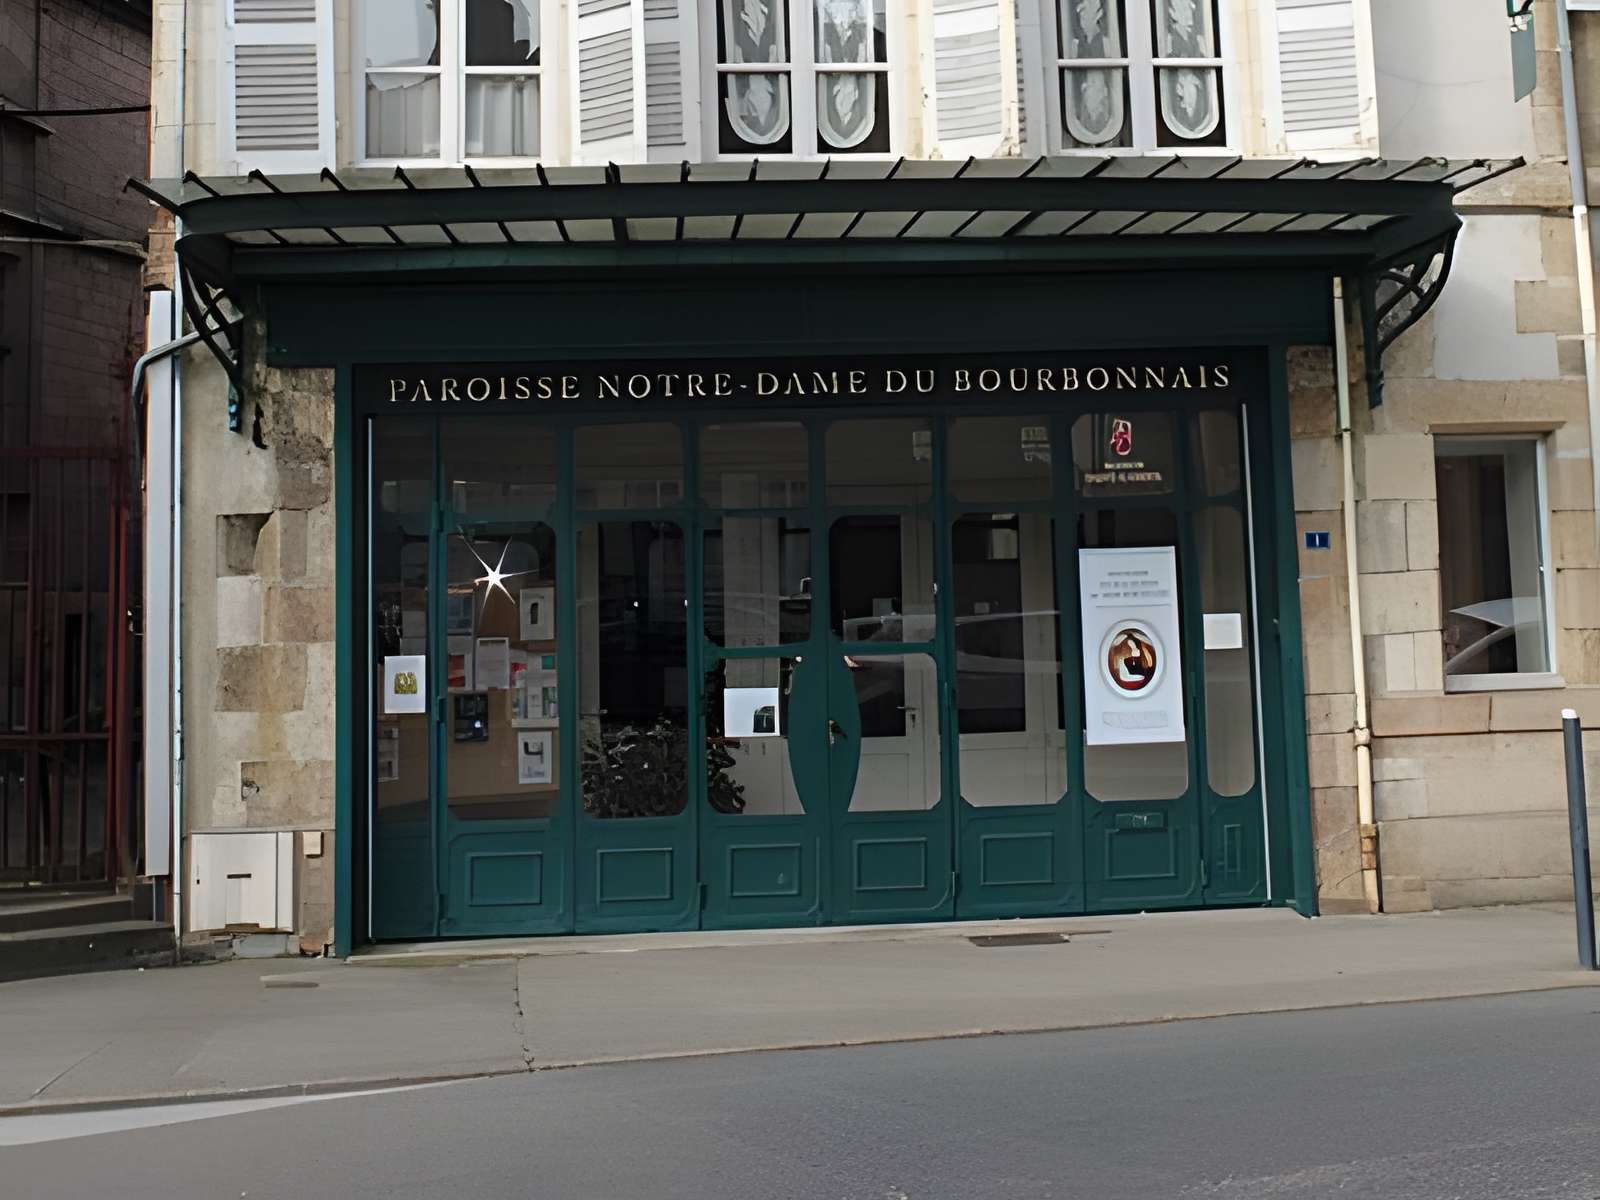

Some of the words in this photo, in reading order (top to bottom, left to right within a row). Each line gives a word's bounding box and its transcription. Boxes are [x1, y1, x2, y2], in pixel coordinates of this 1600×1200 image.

[389, 375, 581, 402] PAROISSE
[597, 370, 868, 400] NOTRE-DAME
[885, 369, 935, 393] DU
[954, 364, 1230, 392] BOURBONNAIS
